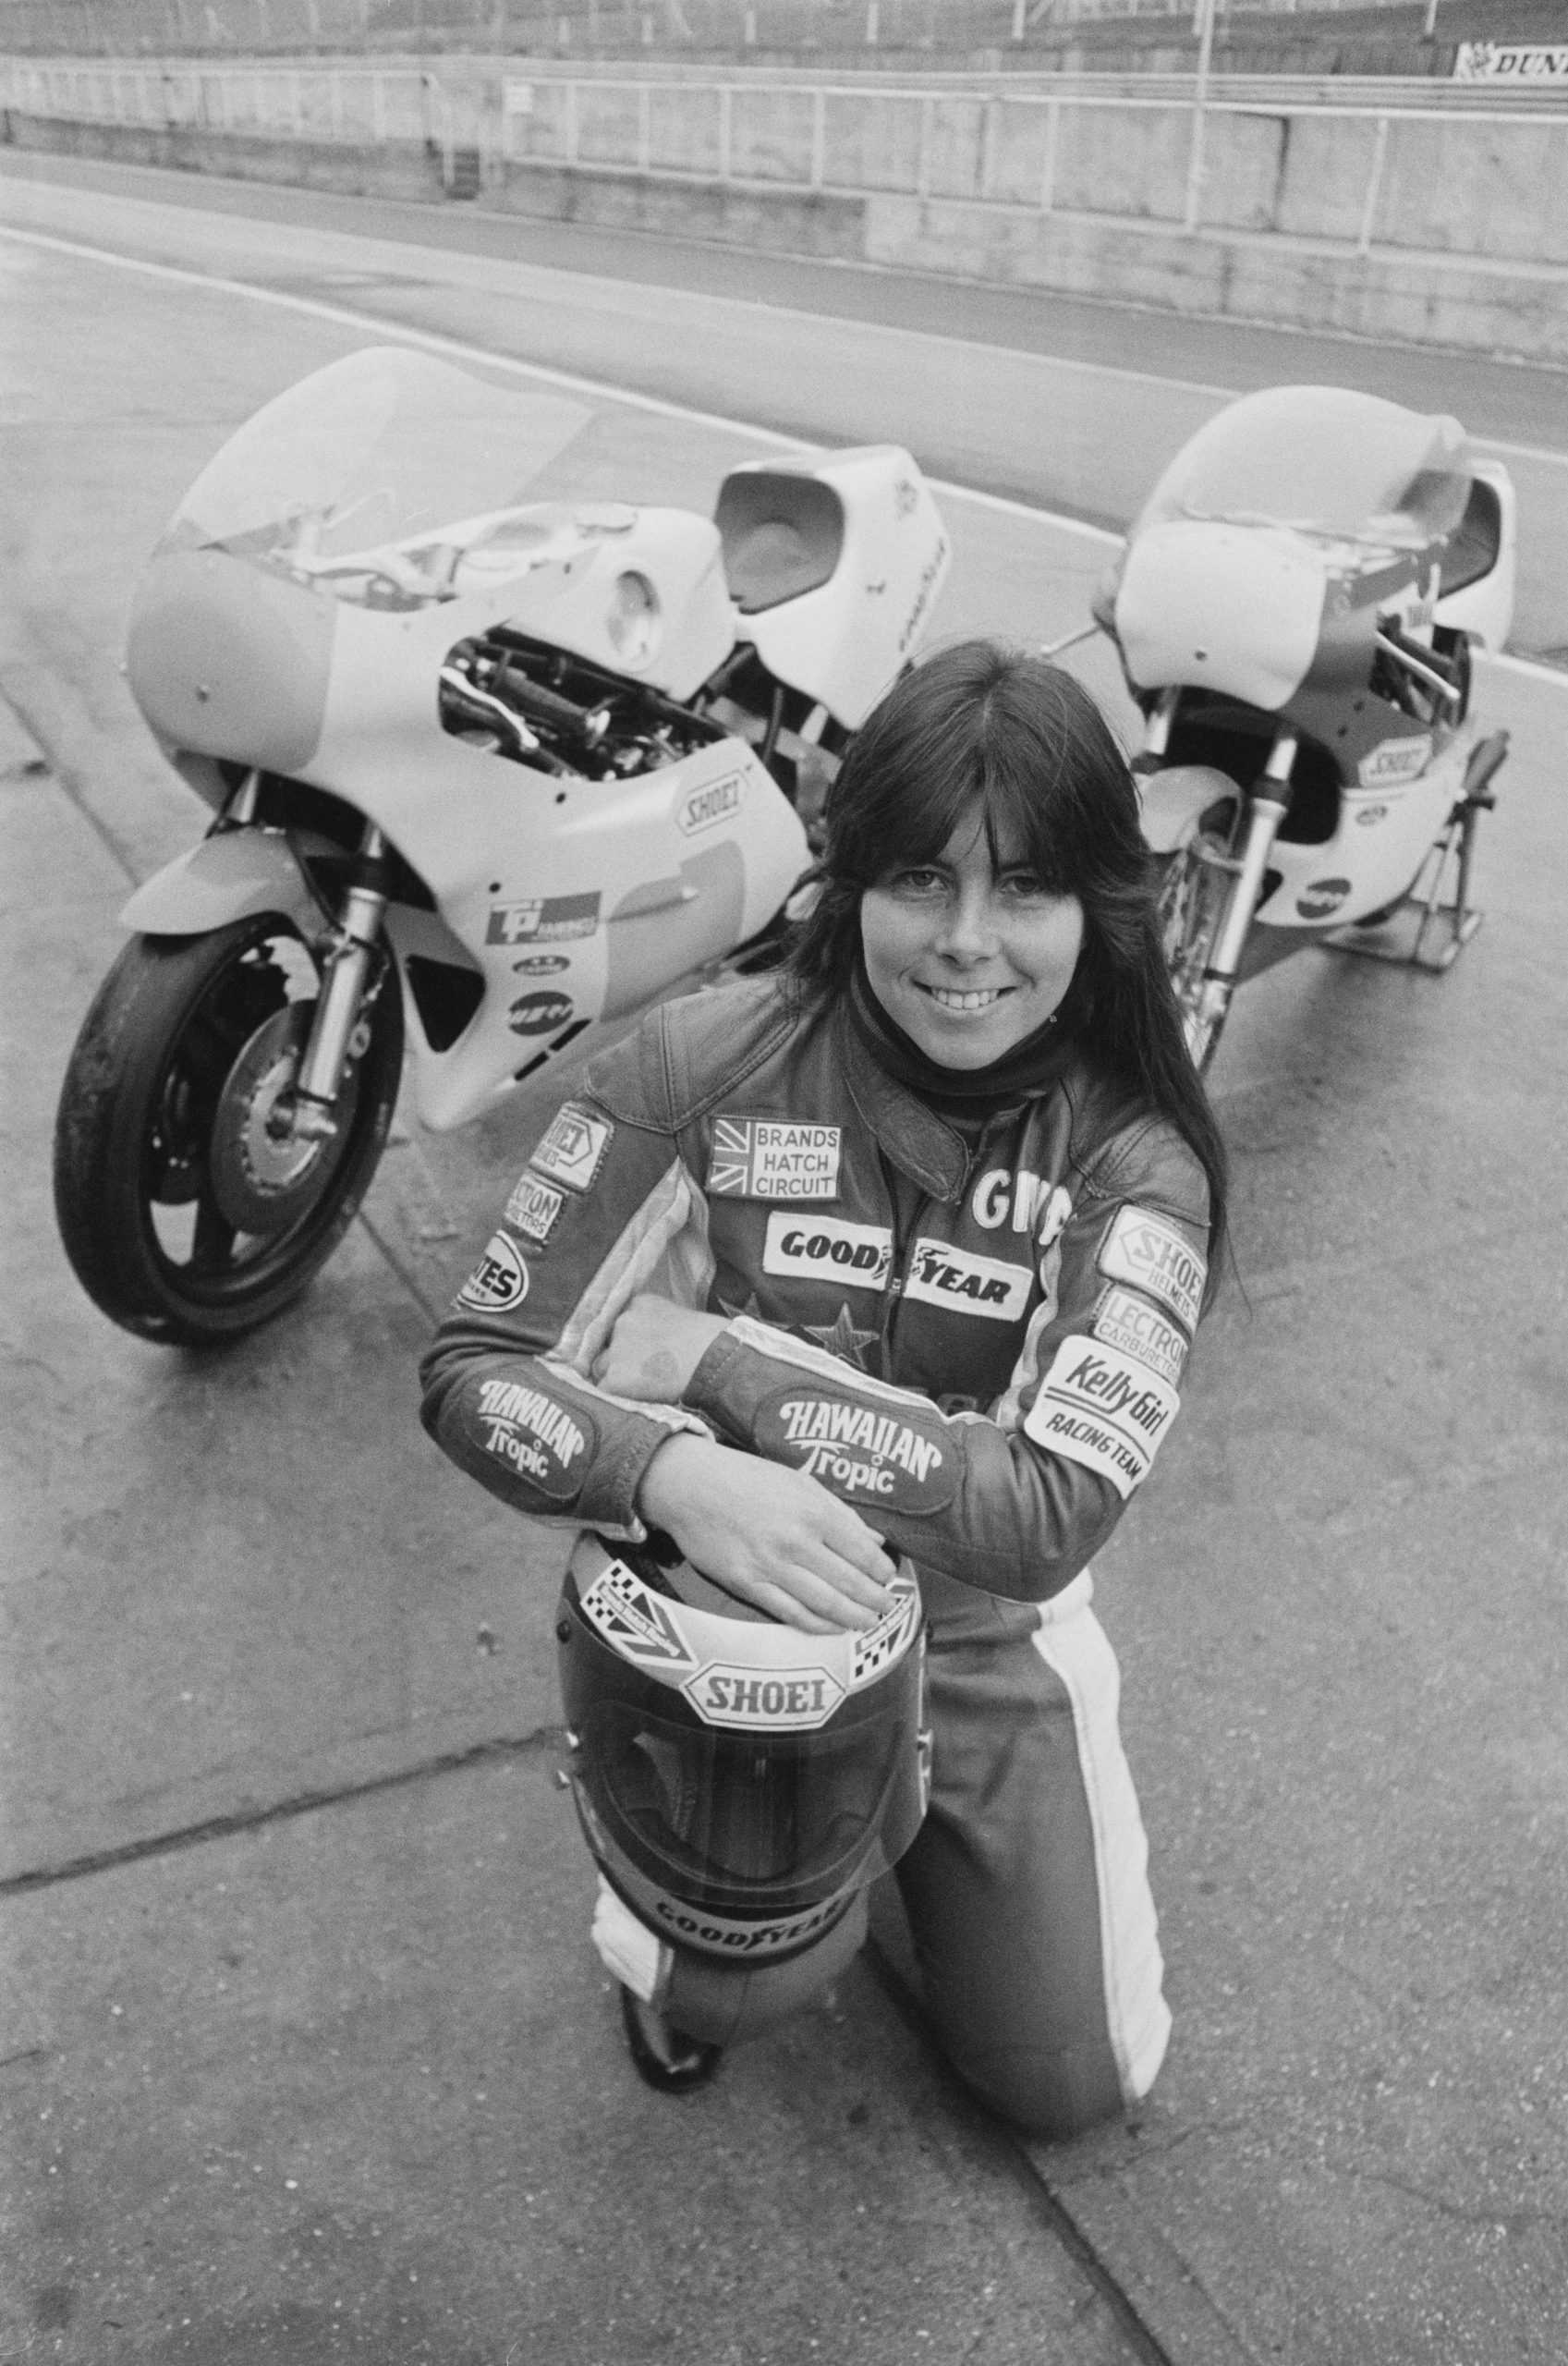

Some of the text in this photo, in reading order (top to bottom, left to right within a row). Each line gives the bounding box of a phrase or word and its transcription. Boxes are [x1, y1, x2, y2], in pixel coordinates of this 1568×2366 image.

[1494, 53, 1568, 74] DUN
[757, 1118, 839, 1148] BRANDS
[756, 1177, 833, 1196] CIRCUIT
[764, 1153, 830, 1173] HATCH
[1148, 1267, 1192, 1318] HELMETS
[477, 1380, 585, 1469] HAWAIIAN
[480, 1417, 549, 1477] Tropic
[779, 1401, 942, 1482] HAWAIIAN
[1046, 1412, 1143, 1482] RACING TEAM
[789, 1439, 895, 1494] Tropic
[706, 1676, 826, 1715] SHOEI
